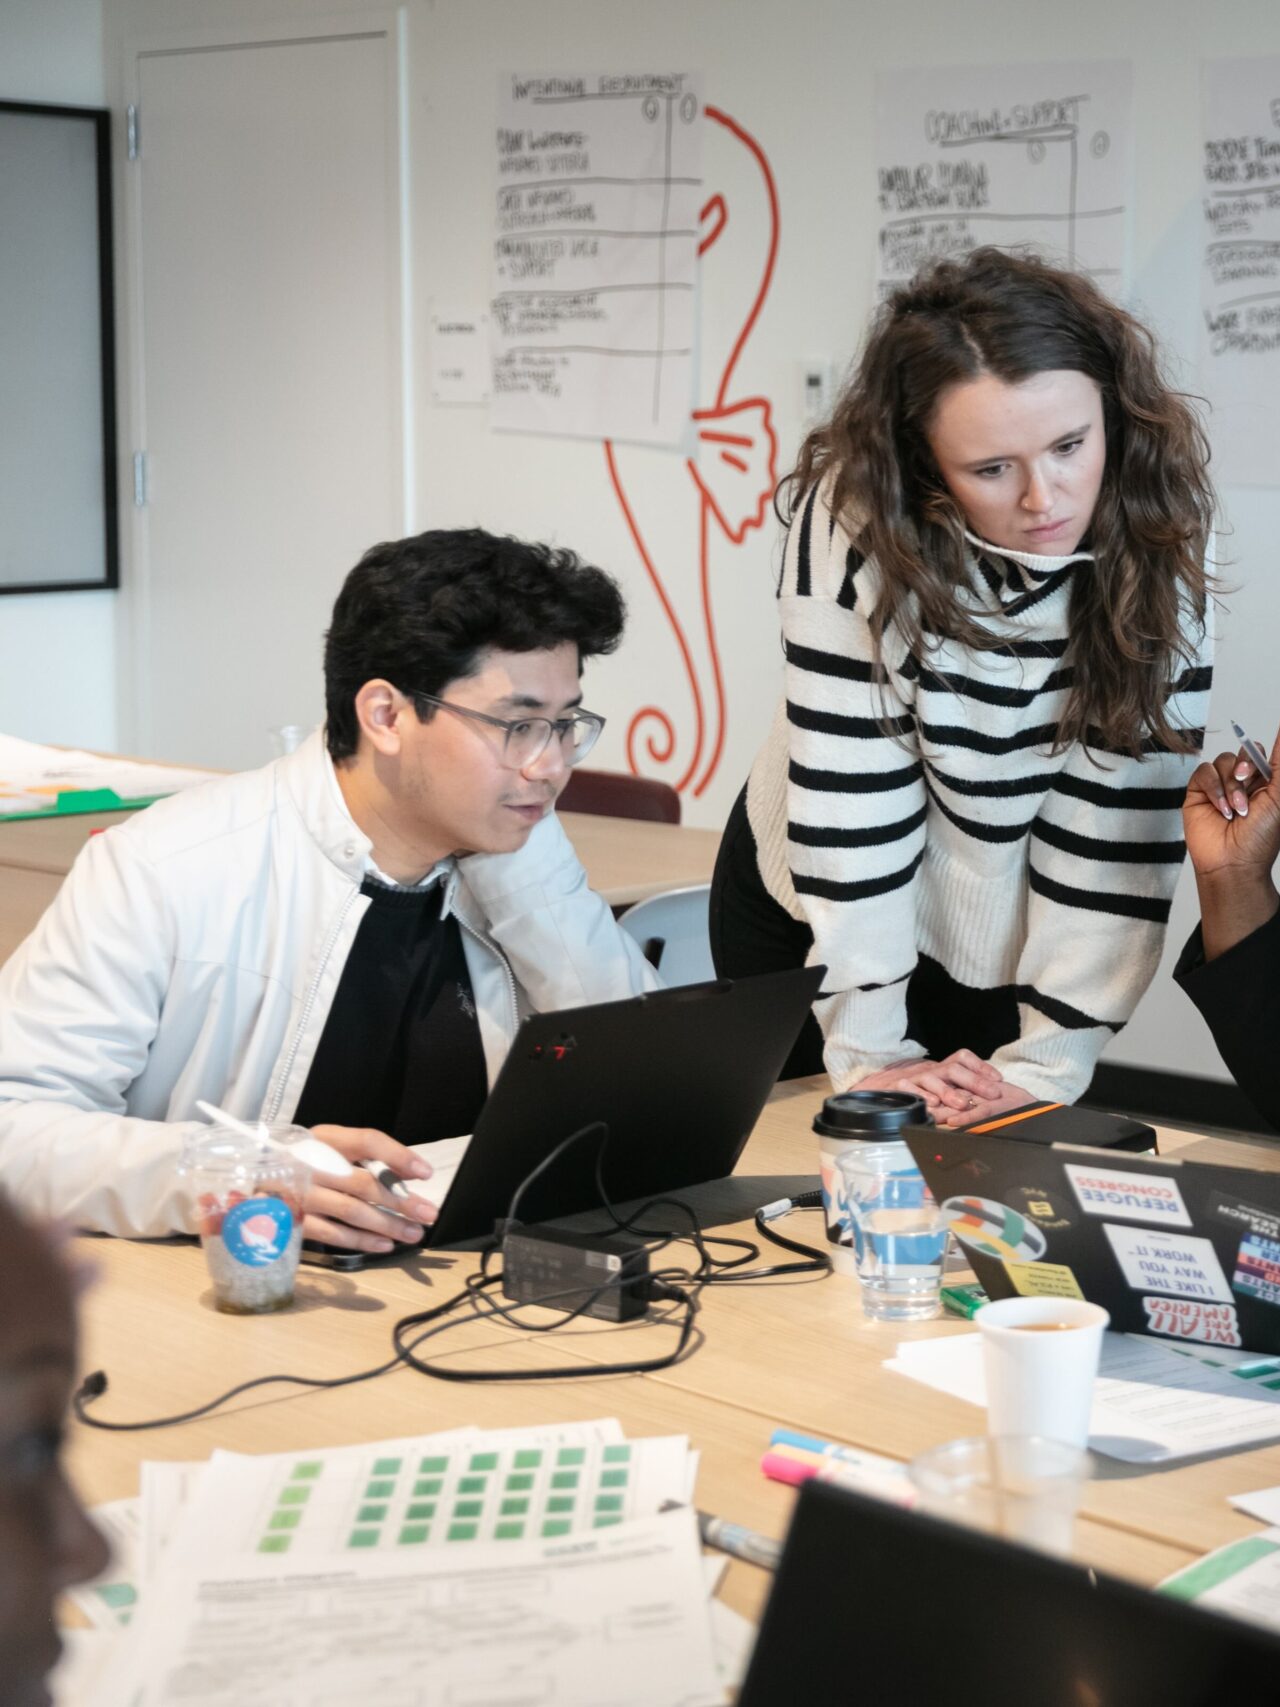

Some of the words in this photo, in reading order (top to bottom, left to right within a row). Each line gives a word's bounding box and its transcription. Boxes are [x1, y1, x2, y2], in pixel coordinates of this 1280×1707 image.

[1075, 1176, 1173, 1198] CONGRESS
[1083, 1187, 1180, 1212] REFUGEE
[1217, 1204, 1280, 1230] SEARCH
[1152, 1247, 1198, 1264] WORK
[1138, 1260, 1170, 1275] YOU
[1174, 1265, 1207, 1280] WAY
[1145, 1275, 1171, 1289] THE
[1176, 1280, 1207, 1295] LIKE
[1148, 1299, 1231, 1321] AMERICA
[1154, 1311, 1200, 1336] ALL
